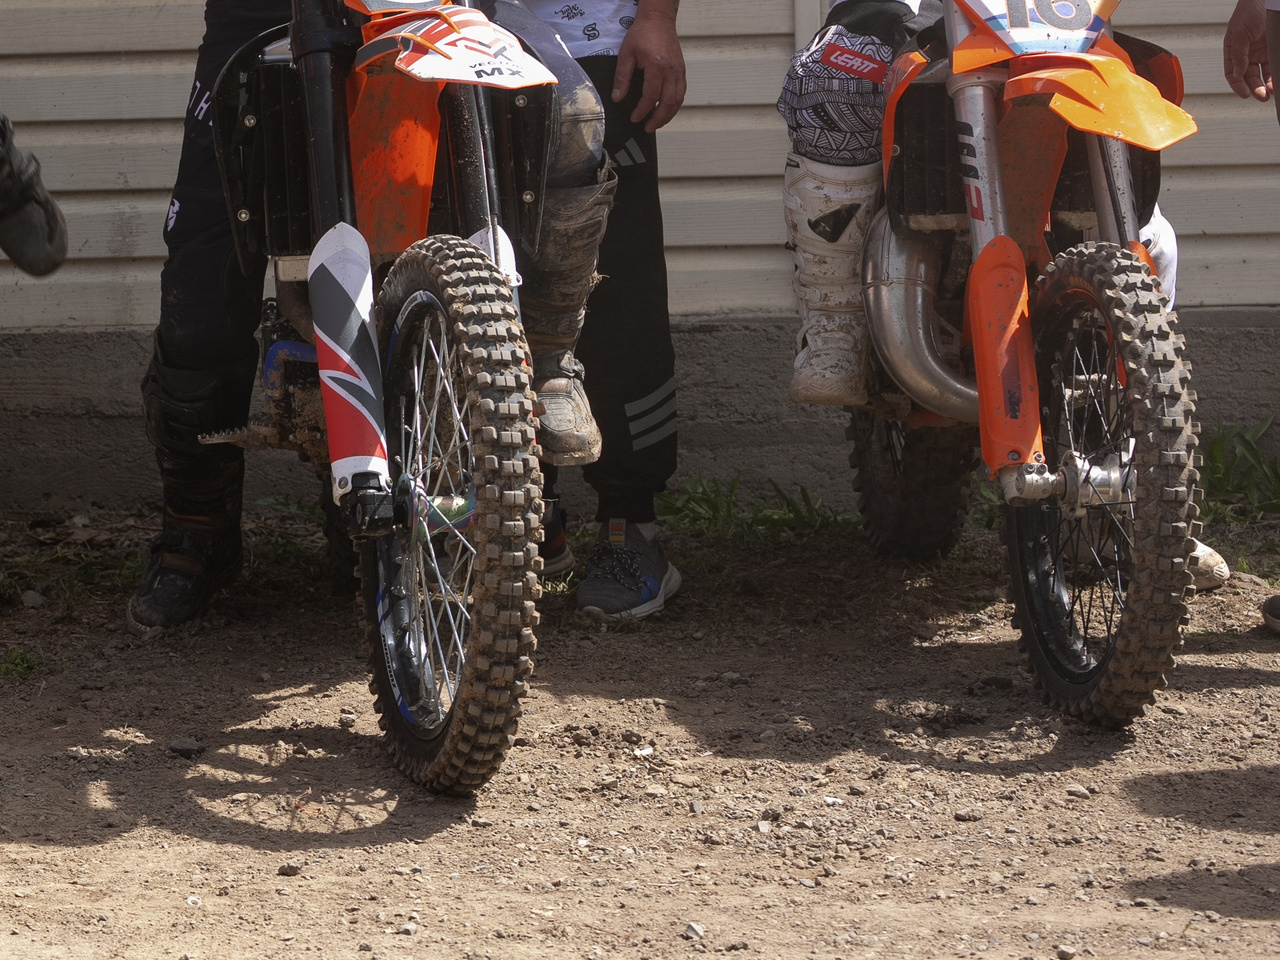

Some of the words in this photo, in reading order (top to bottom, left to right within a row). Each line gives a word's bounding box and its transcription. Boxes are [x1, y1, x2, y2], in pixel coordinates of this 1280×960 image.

[582, 22, 600, 41] S
[829, 50, 879, 74] LEATT
[474, 67, 525, 79] MX
